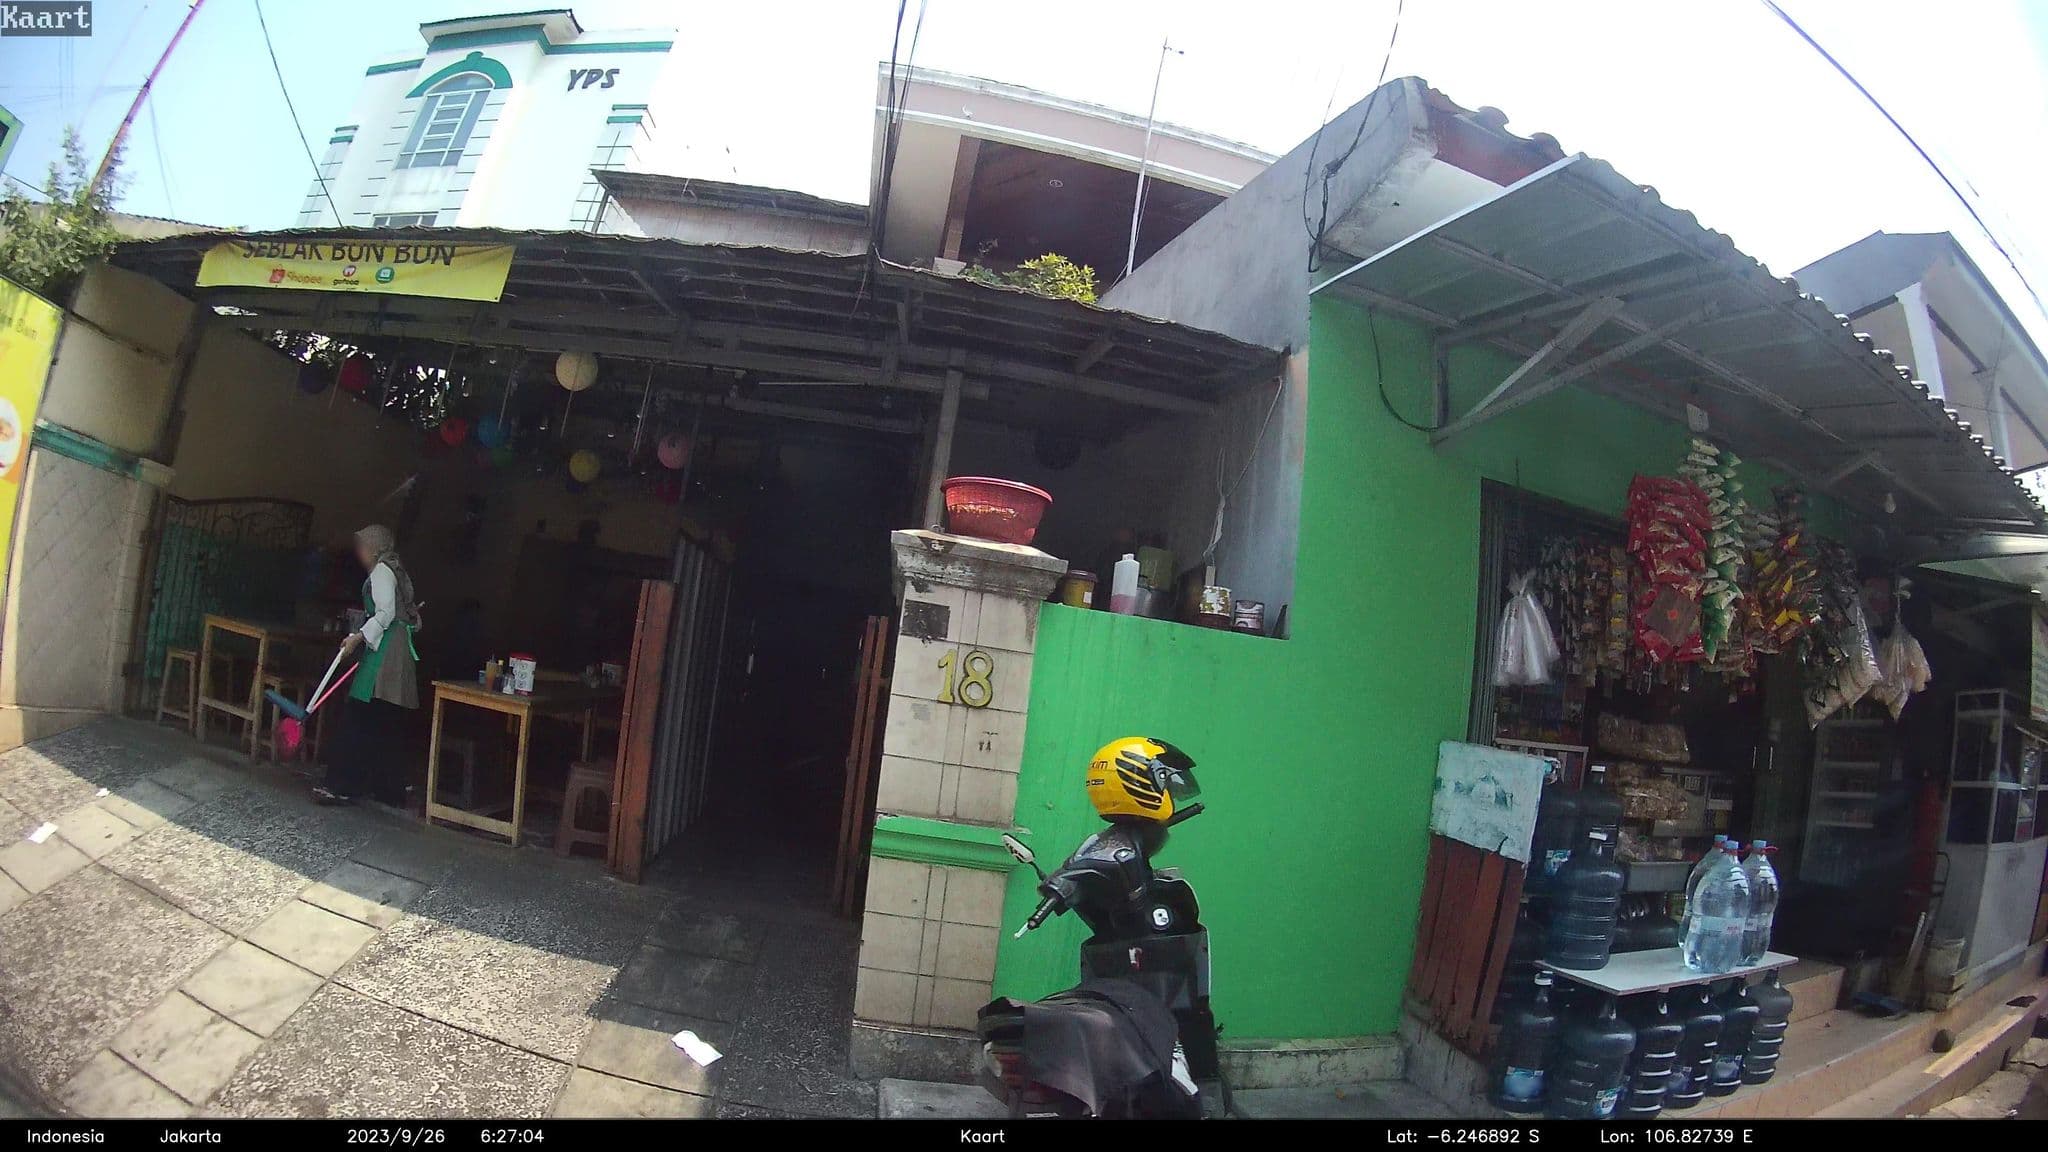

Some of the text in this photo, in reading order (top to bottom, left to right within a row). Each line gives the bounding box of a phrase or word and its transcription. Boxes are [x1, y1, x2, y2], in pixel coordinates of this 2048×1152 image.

[566, 67, 620, 92] YPS
[243, 240, 456, 266] SEBLAK BUN BUN
[287, 271, 322, 285] Shopee
[937, 648, 994, 709] 18
